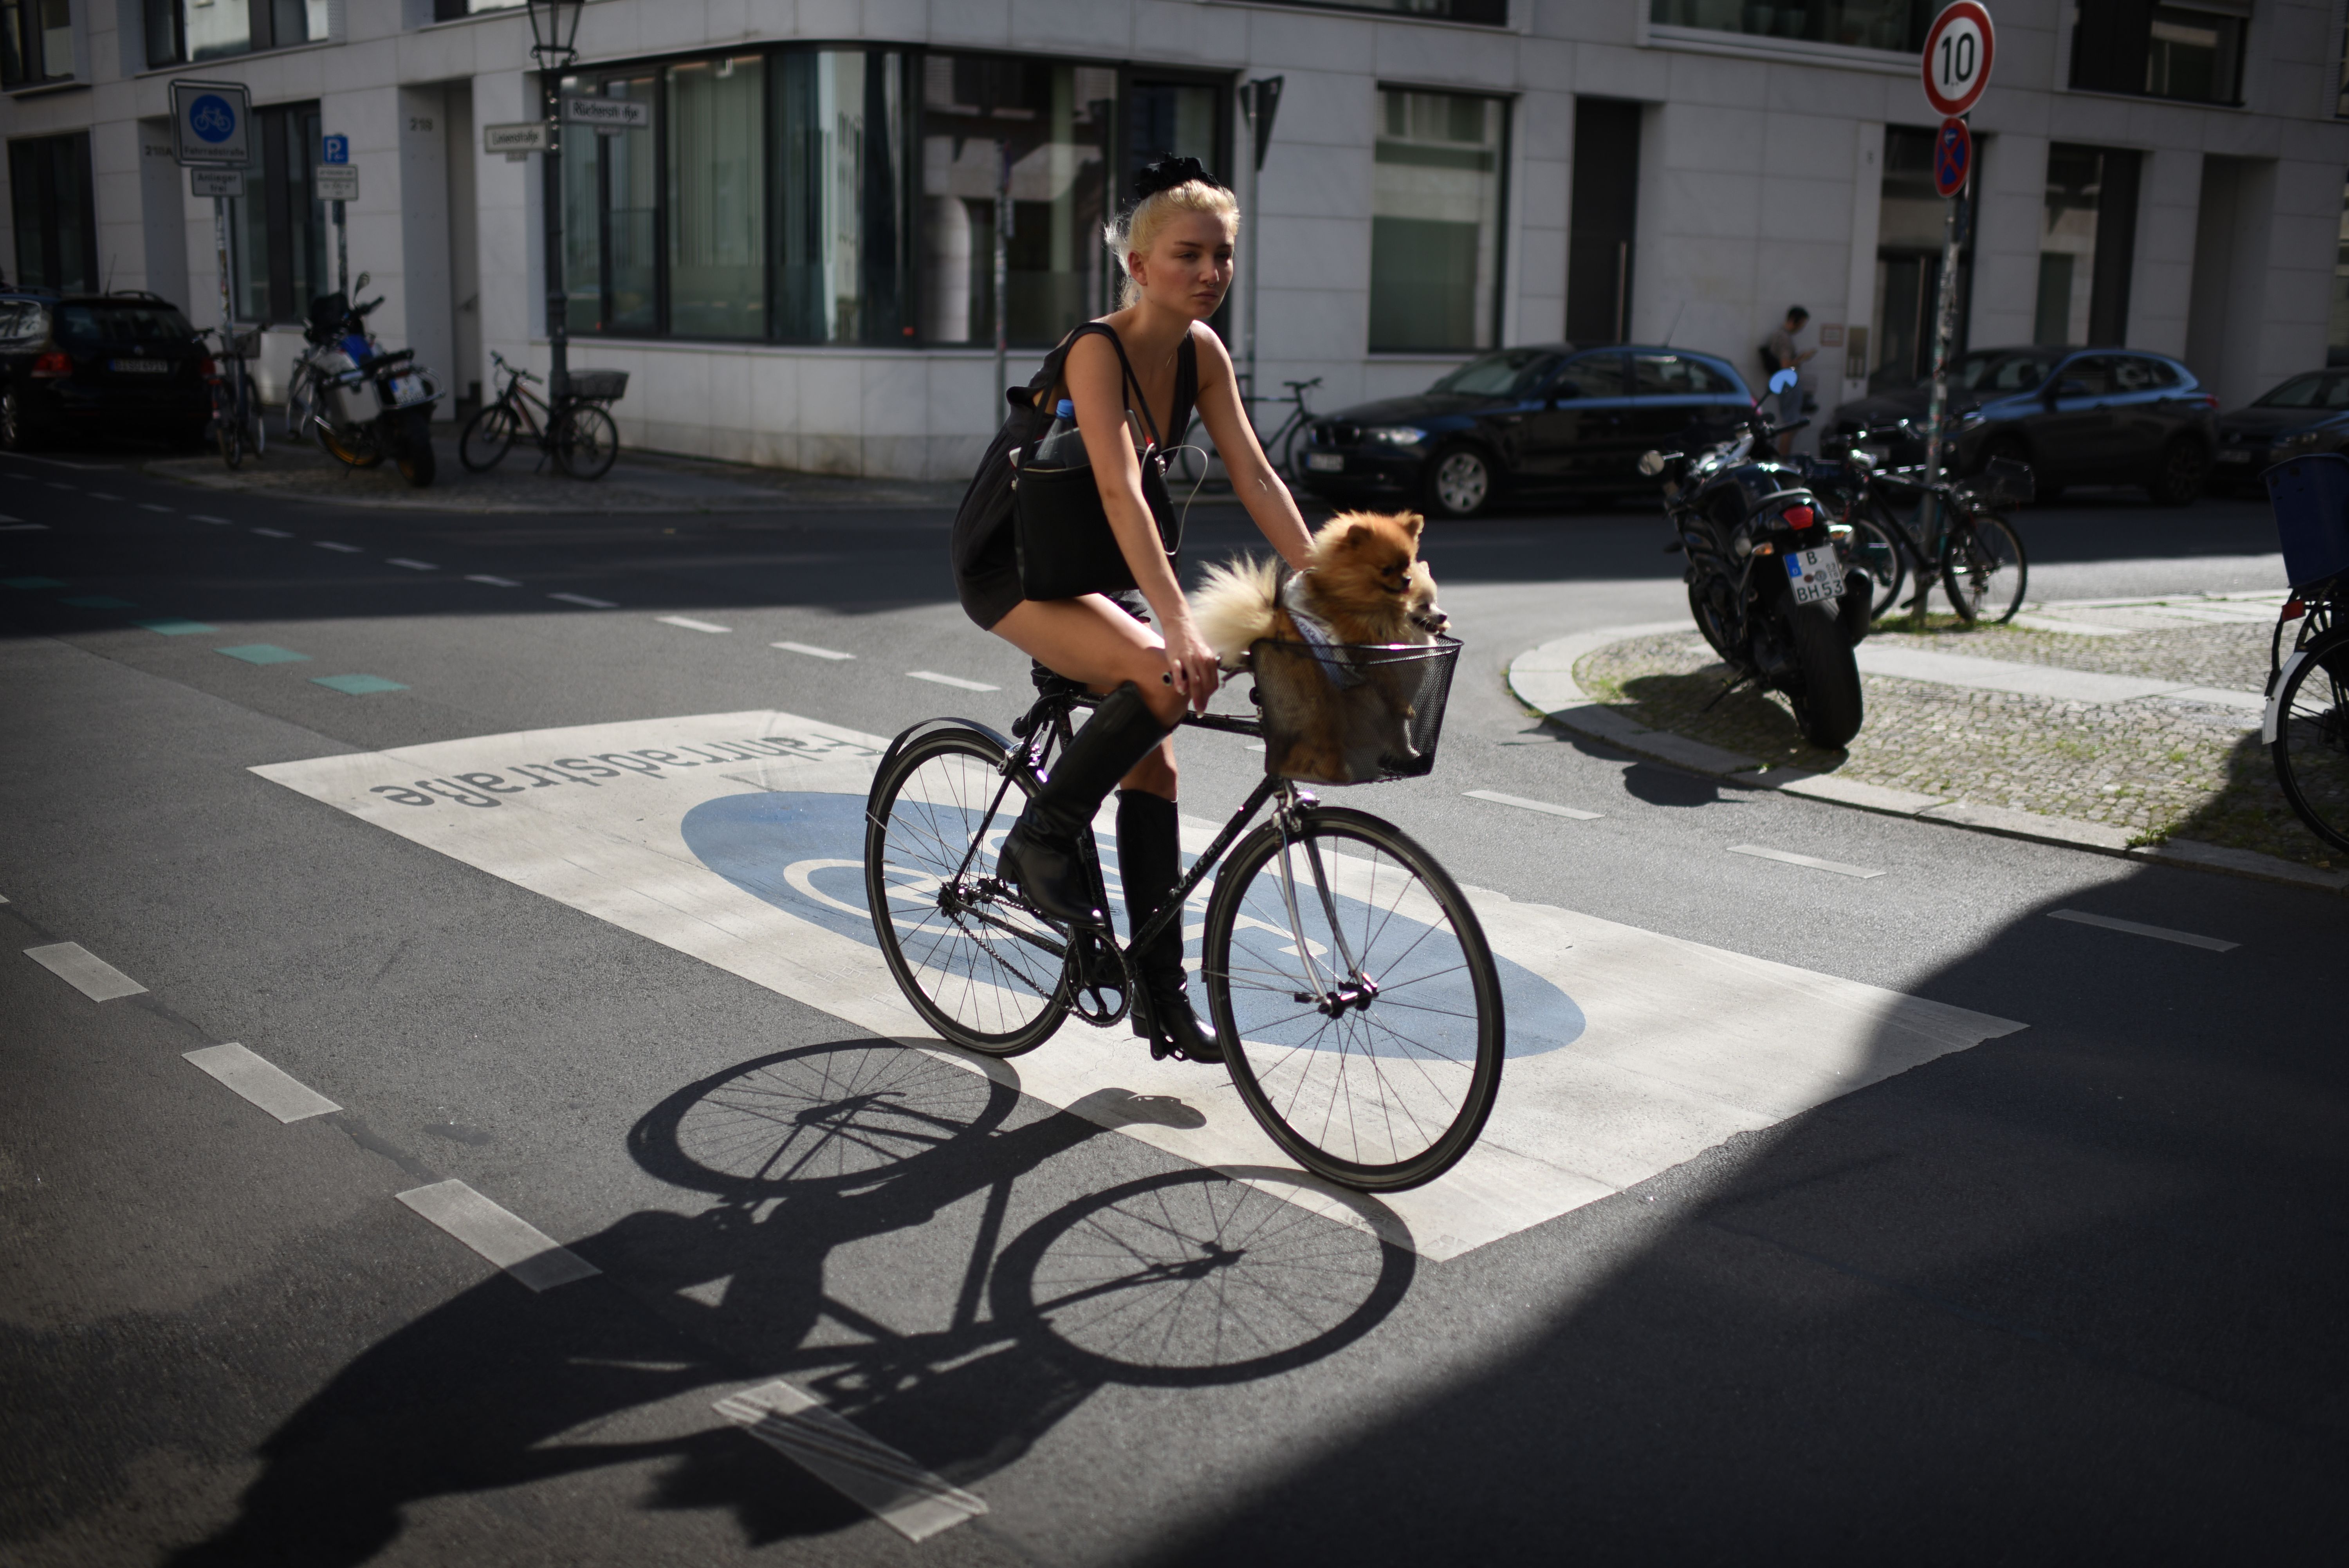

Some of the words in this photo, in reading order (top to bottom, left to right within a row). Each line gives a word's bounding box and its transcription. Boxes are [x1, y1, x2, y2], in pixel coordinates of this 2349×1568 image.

[1942, 32, 1974, 85] 10
[184, 146, 245, 157] Fahrradstraße
[198, 172, 236, 183] Anlieger
[1806, 551, 1817, 565] B
[1797, 585, 1820, 601] BH
[1822, 579, 1842, 596] 53
[370, 733, 886, 808] Fahrradstraße
